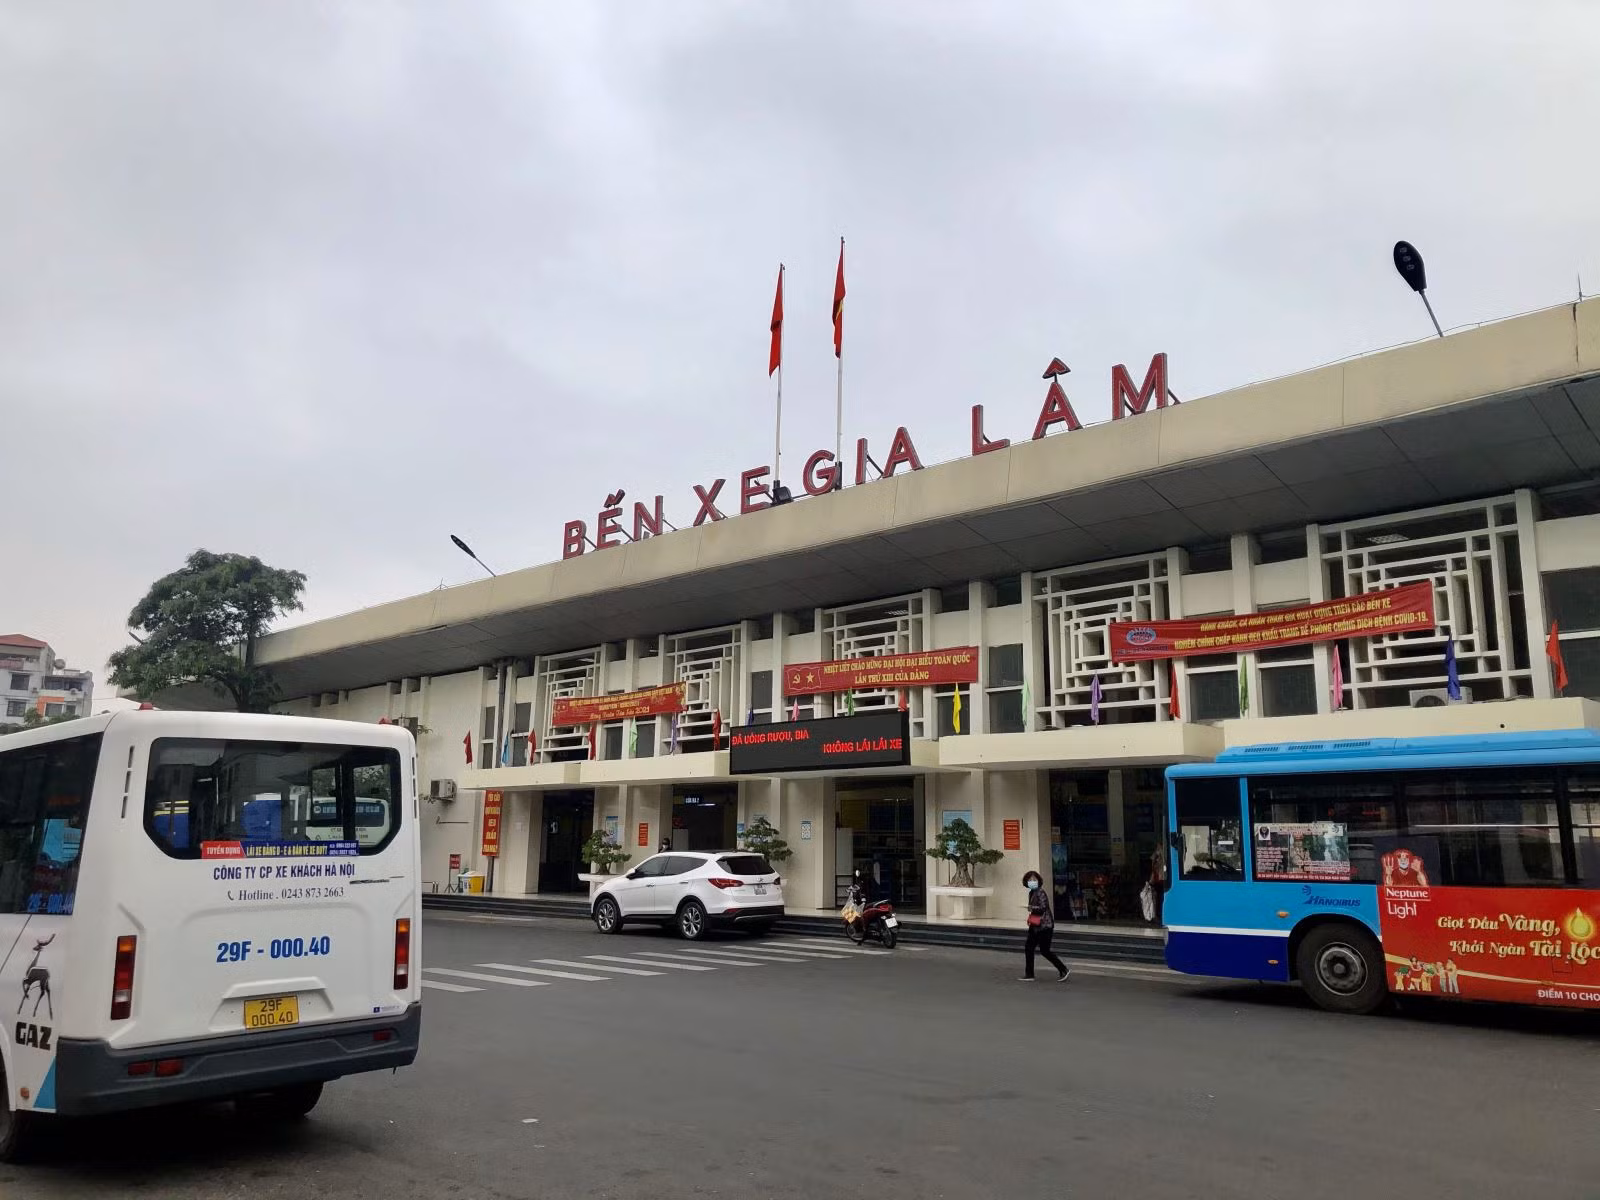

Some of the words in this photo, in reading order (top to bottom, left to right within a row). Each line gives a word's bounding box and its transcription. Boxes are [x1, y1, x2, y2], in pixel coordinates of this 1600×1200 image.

[563, 489, 664, 560] BẾN
[693, 469, 771, 518] XE
[803, 426, 923, 496] GIA
[972, 352, 1170, 456] LÂM
[1333, 603, 1350, 615] TRÊN
[1352, 602, 1366, 613] CÁC
[1367, 597, 1381, 610] BẾN
[1382, 598, 1391, 609] XE
[1280, 626, 1300, 638] TRANG
[1310, 621, 1333, 634] PHÒNG
[1333, 619, 1356, 632] CHỐNG
[1357, 618, 1374, 631] DỊCH
[1374, 616, 1393, 630] BỆNH
[824, 664, 839, 677] NHIỆT
[839, 663, 850, 674] LIỆT
[851, 660, 866, 671] CHÀO
[866, 660, 882, 670] MỪNG
[883, 659, 894, 670] ĐẠI
[906, 658, 918, 669] ĐẠI
[918, 653, 933, 666] BIỂU
[934, 654, 952, 664] TOÀN
[952, 651, 971, 665] QUỐC
[855, 673, 867, 684] LẦN
[868, 672, 881, 683] THỨ
[882, 673, 894, 682] XIII
[895, 671, 908, 681] CỦA
[909, 669, 929, 680] ĐẢNG
[795, 729, 810, 740] BIA
[822, 740, 854, 754] KHÔNG
[856, 738, 871, 752] LÁI
[889, 738, 903, 750] XE
[207, 845, 225, 855] TUYỂN
[225, 846, 241, 856] DỤNG
[213, 865, 242, 880] CÔNG
[245, 867, 256, 879] TY
[259, 866, 273, 879] CP
[275, 865, 288, 878] XE
[290, 862, 322, 878] KHÁCH
[324, 862, 337, 877] HÀ
[339, 861, 355, 878] NỘI
[238, 889, 274, 901] Hotline
[281, 888, 303, 899] 0243
[305, 887, 322, 898] 873
[323, 887, 344, 898] 2663
[1386, 888, 1428, 900] Neptune
[1387, 902, 1417, 919] Light
[1438, 916, 1465, 929] Giọt
[1500, 913, 1560, 937] Vàng,
[216, 941, 252, 963] 29F
[270, 936, 330, 959] 000.40
[1449, 940, 1484, 955] Khởi
[1489, 941, 1525, 958] Ngàn
[1538, 988, 1564, 999] ĐIỂM
[1566, 991, 1578, 1000] 10
[1579, 992, 1600, 1001] CHO
[260, 999, 282, 1013] 29F
[252, 1011, 293, 1027] 000.40
[15, 1021, 52, 1051] GAZ
